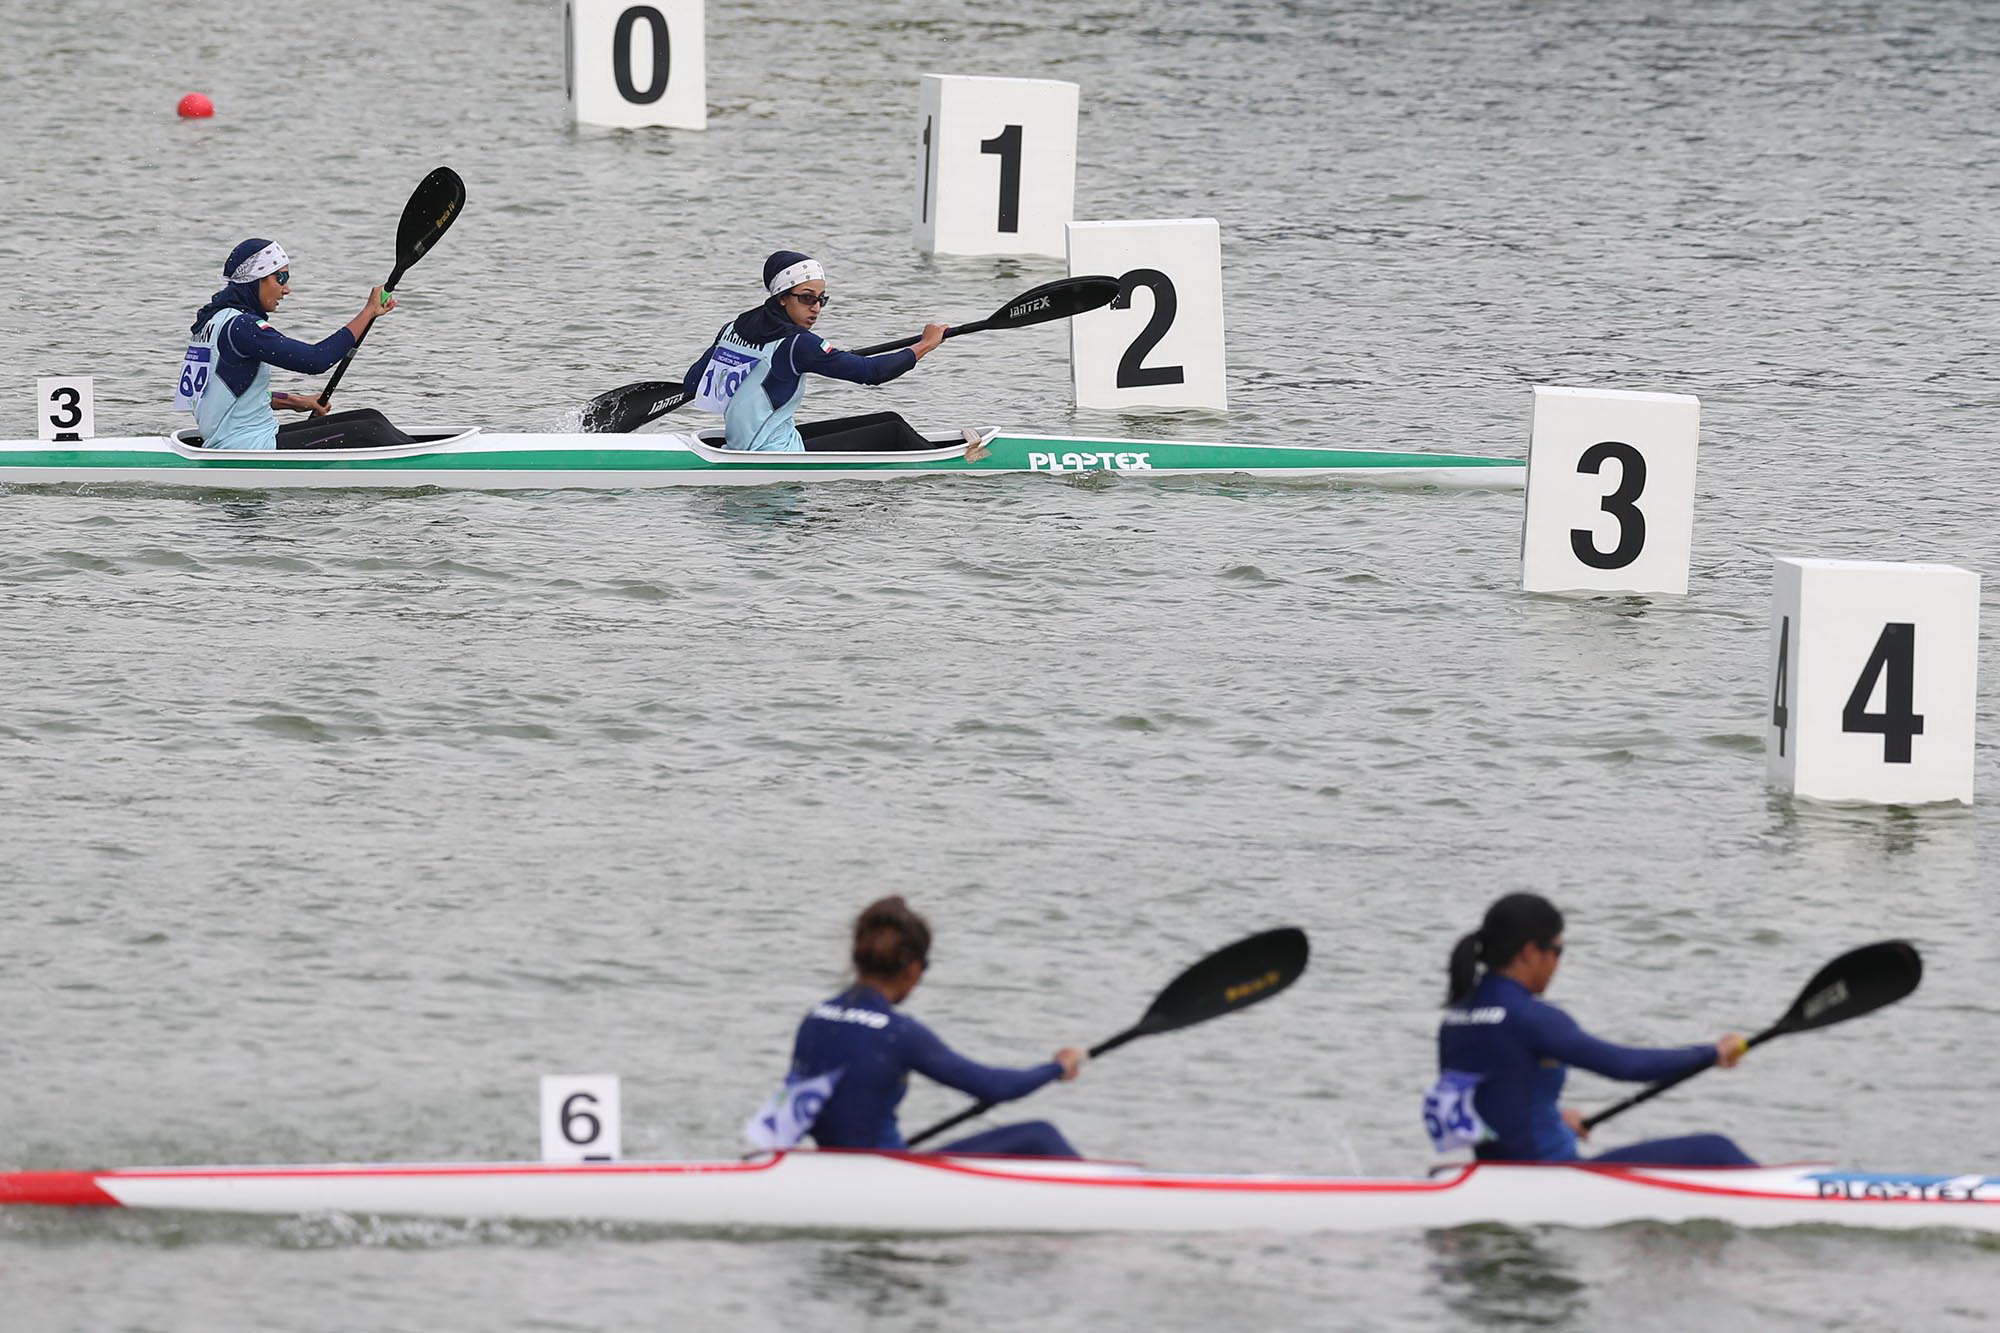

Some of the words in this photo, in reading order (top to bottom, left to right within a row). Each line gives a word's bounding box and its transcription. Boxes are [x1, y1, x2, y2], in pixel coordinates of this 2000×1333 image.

[613, 5, 670, 105] 0
[981, 124, 1022, 233] 1
[1109, 268, 1184, 389] 2
[49, 387, 83, 429] 3
[179, 364, 208, 398] 64
[1027, 452, 1152, 471] PLASTEX
[1570, 441, 1647, 570] 3
[1842, 622, 1925, 763] 4
[560, 1092, 602, 1146] 6
